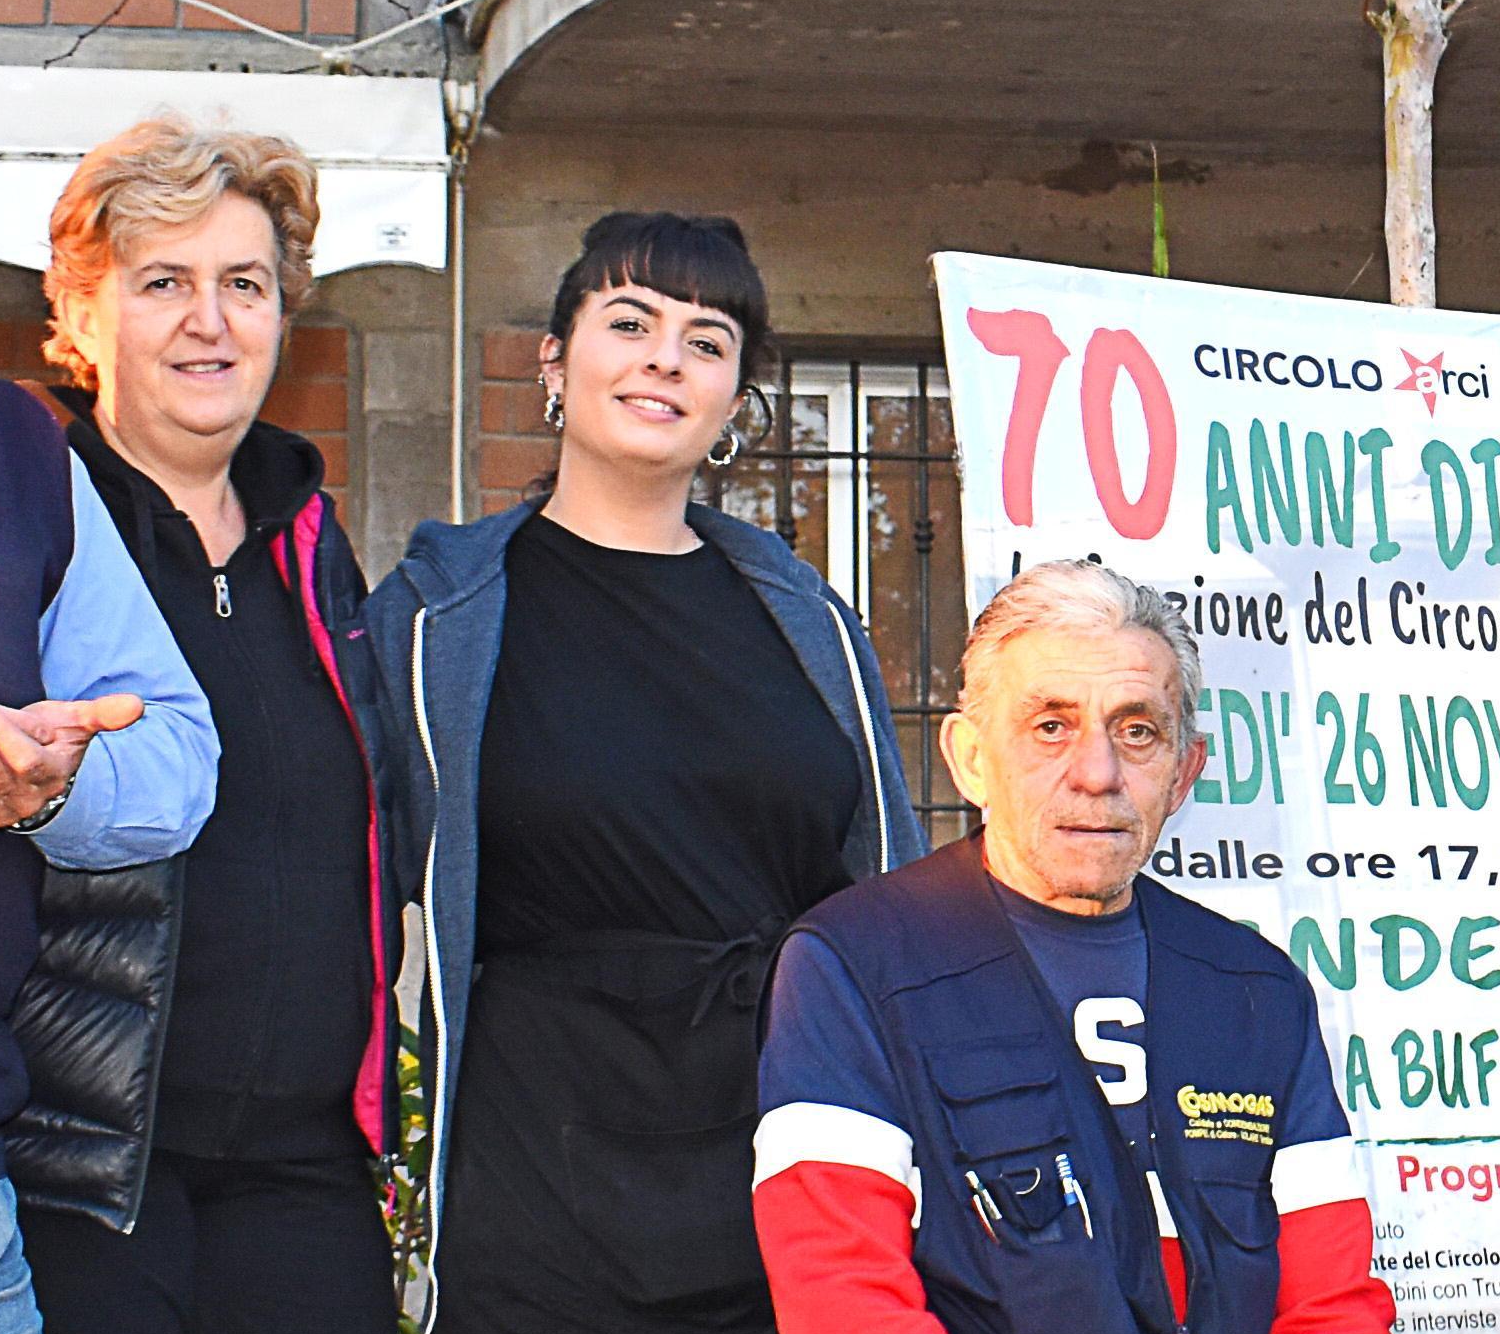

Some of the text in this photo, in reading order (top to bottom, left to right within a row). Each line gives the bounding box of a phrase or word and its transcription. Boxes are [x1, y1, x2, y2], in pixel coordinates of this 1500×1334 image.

[1193, 343, 1384, 394] CIRCOLO
[1413, 355, 1491, 403] arci
[967, 306, 1178, 541] 70
[1205, 420, 1402, 565] ANNI
[1304, 569, 1369, 649] del
[1194, 687, 1290, 805] EDI'
[1316, 690, 1386, 807] 26
[1151, 837, 1284, 880] dalle
[1306, 851, 1396, 879] ore
[1402, 1250, 1430, 1271] del
[1435, 1247, 1500, 1269] Circolo
[1433, 1280, 1468, 1300] con
[1412, 1309, 1498, 1333] interviste
